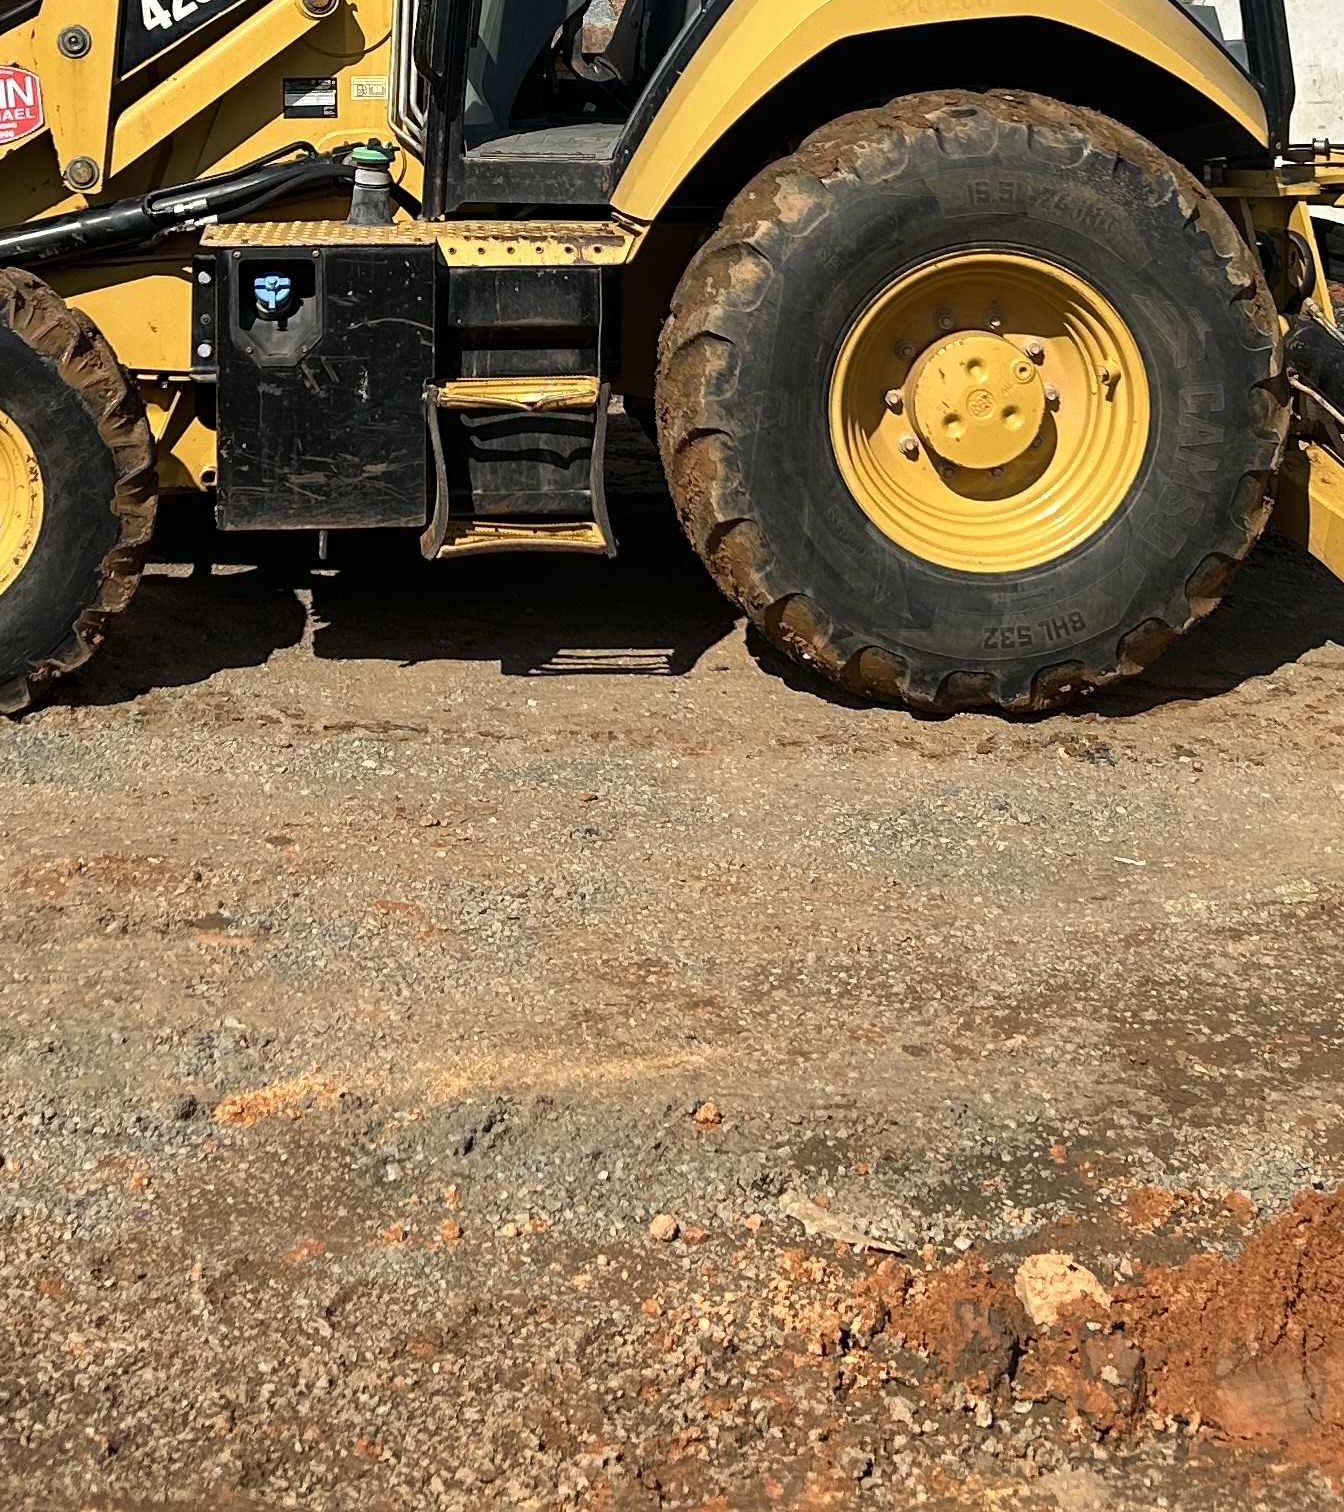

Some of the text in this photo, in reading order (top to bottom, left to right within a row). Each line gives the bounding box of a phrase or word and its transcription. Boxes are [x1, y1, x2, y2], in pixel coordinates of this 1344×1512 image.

[1139, 383, 1226, 559] CAMSO
[984, 610, 1088, 649] BHL 532
